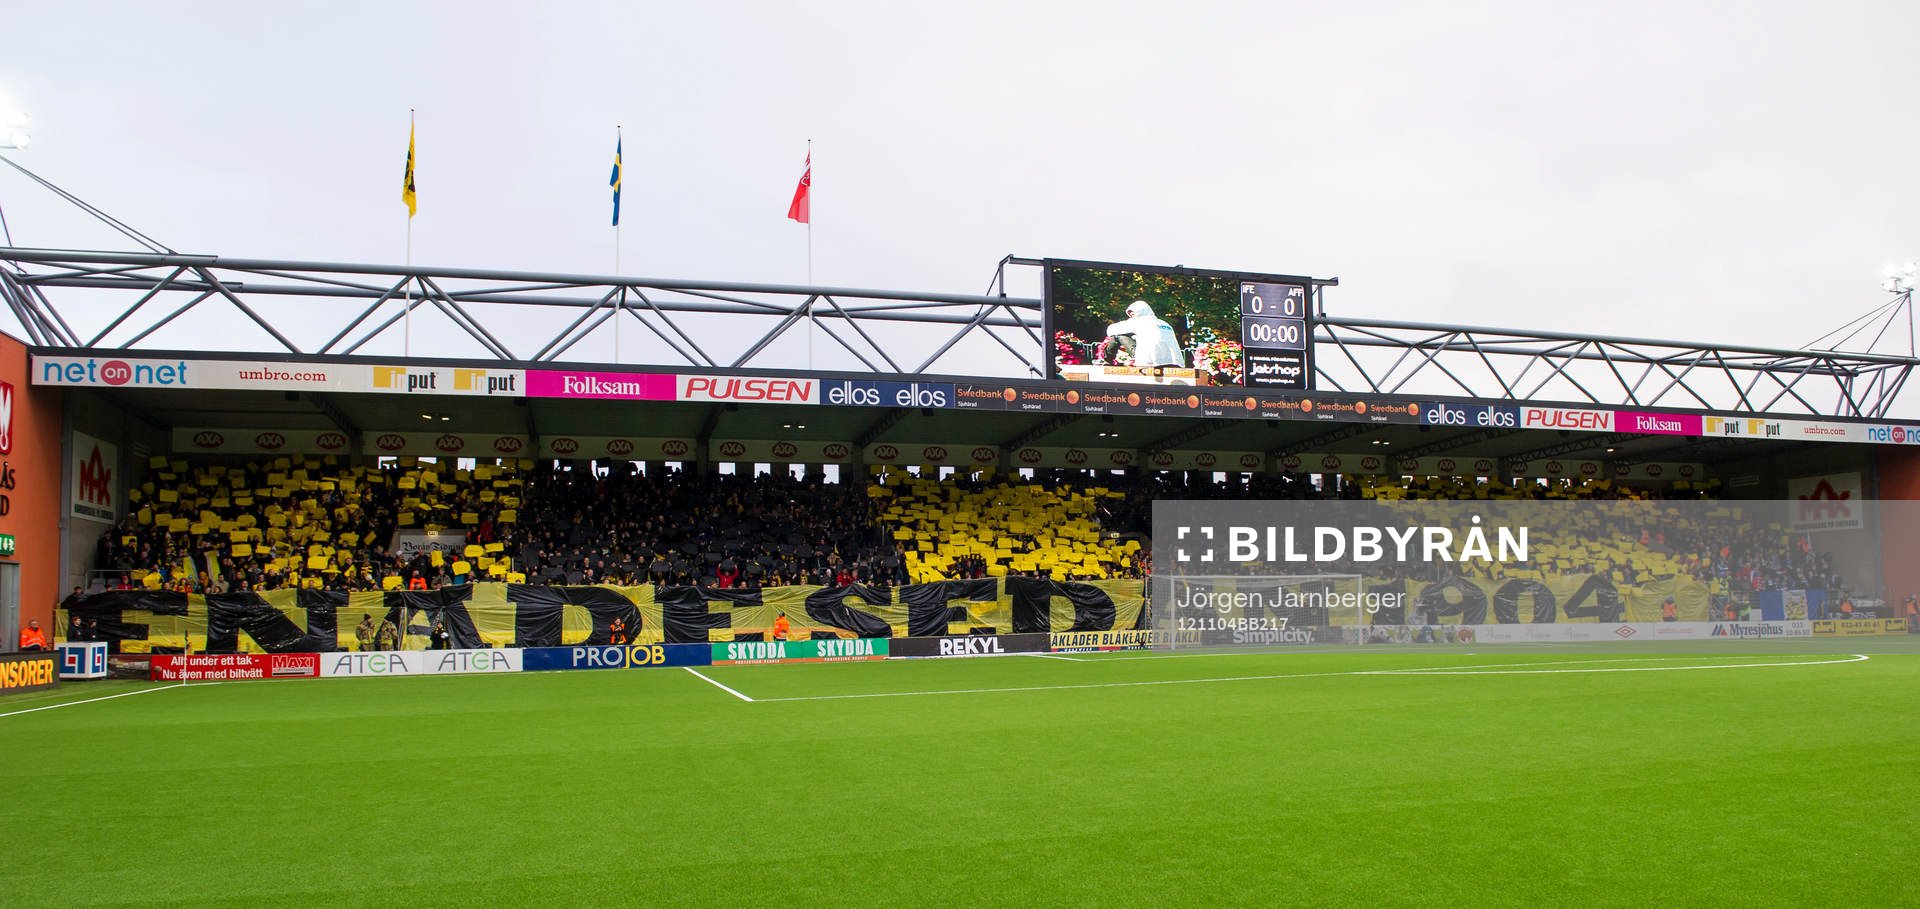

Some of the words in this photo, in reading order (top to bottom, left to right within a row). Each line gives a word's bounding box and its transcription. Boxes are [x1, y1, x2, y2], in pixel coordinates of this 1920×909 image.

[1251, 296, 1262, 314] 0
[1284, 298, 1295, 316] 0
[1250, 323, 1298, 344] 00:00
[239, 367, 327, 382] umbro.com
[563, 375, 640, 396] Folksam
[685, 378, 812, 402] PULSEN
[829, 381, 880, 405] ellos
[896, 383, 946, 407] ellos
[957, 388, 1002, 399] Swedbank
[1022, 391, 1065, 401] Swedbank
[1085, 393, 1126, 403] Swedbank
[1146, 396, 1186, 406] Swedbank
[1204, 398, 1243, 408] Swedbank
[1262, 400, 1300, 410] Swedbank
[1316, 402, 1354, 411] Swedbank
[1370, 404, 1408, 413] Swedbank
[1427, 404, 1466, 424] ellos
[1477, 406, 1515, 427] ellos
[1526, 409, 1609, 429] PULSEN
[1636, 416, 1682, 432] Folksam
[1804, 426, 1846, 436] umbro.com
[196, 433, 221, 446] AXA
[259, 433, 283, 446] AXA
[319, 435, 344, 447] AXA
[379, 435, 404, 448] AXA
[438, 436, 462, 449] AXA
[496, 437, 520, 449] AXA
[554, 439, 577, 450] AXA
[610, 440, 632, 451] AXA
[664, 441, 687, 452] AXA
[722, 442, 744, 453] AXA
[774, 443, 796, 454] AXA
[826, 444, 847, 455] AXA
[876, 445, 897, 456] AXA
[926, 447, 946, 457] AXA
[973, 448, 994, 458] AXA
[1021, 449, 1040, 459] AXA
[1067, 450, 1086, 460] AXA
[1112, 451, 1131, 462] AXA
[1154, 453, 1172, 463] AXA
[1198, 453, 1215, 464] AXA
[1242, 454, 1258, 465] AXA
[79, 443, 111, 507] MAX
[1798, 478, 1851, 521] MAX
[1730, 623, 1783, 639] Myresjöhus
[728, 642, 786, 660] SKYDDA
[817, 639, 874, 657] SKYDDA
[939, 635, 1004, 656] REKYL
[190, 655, 218, 666] under
[221, 655, 235, 666] ett
[236, 655, 253, 665] tak
[272, 655, 315, 668] MAXI
[573, 645, 666, 669] PROJOB
[163, 669, 176, 679] Nu
[205, 668, 227, 679] med
[230, 668, 263, 678] biltvätt
